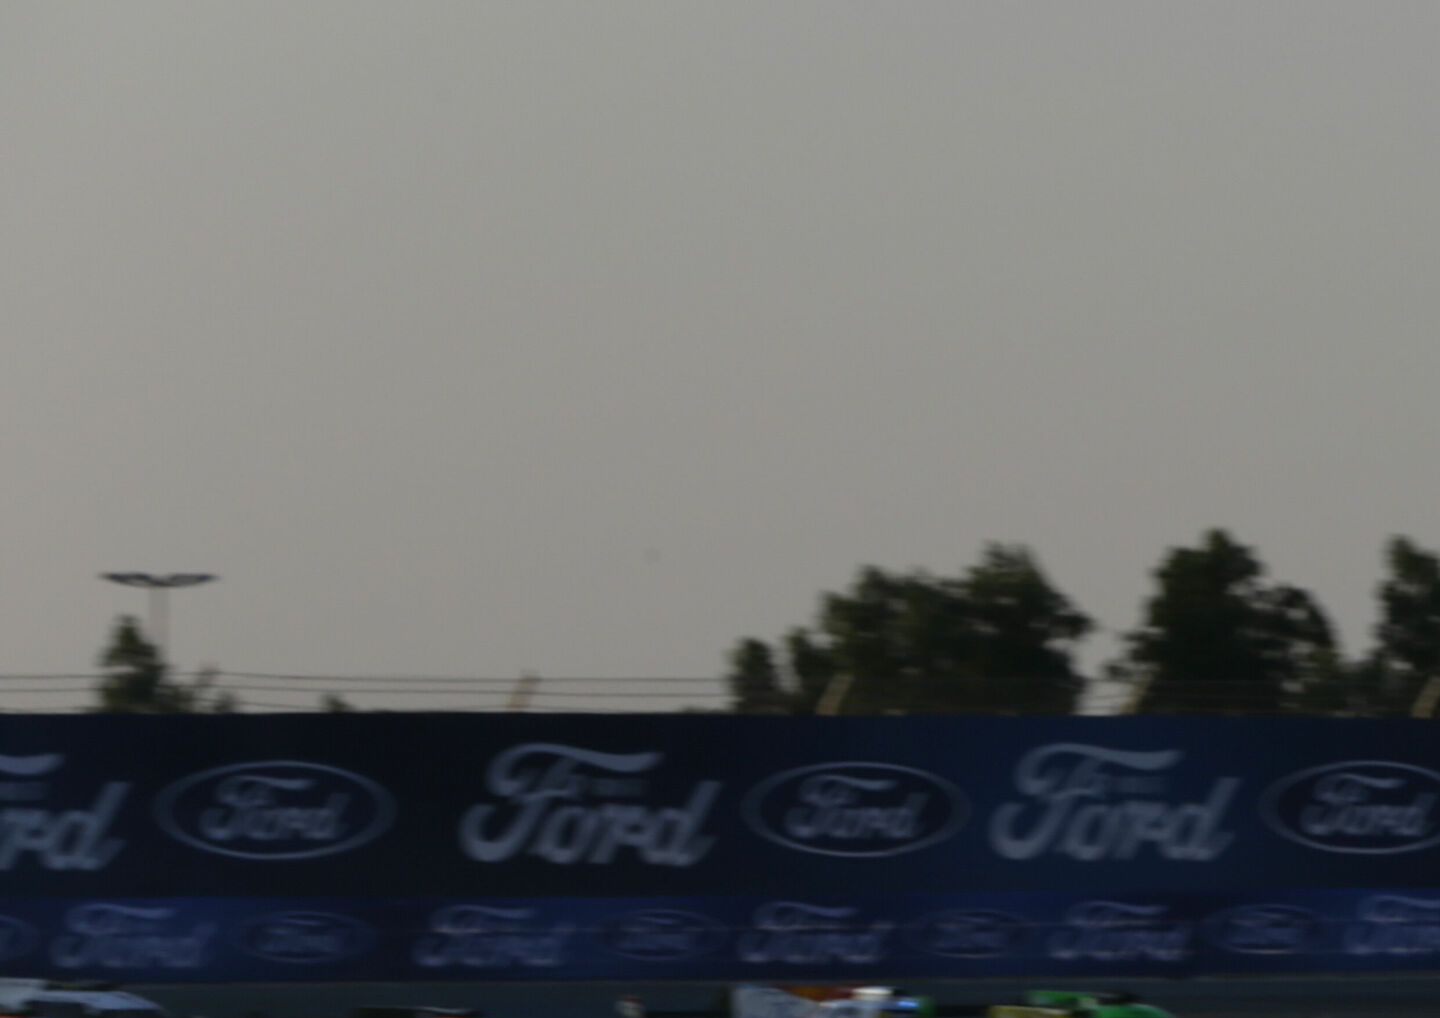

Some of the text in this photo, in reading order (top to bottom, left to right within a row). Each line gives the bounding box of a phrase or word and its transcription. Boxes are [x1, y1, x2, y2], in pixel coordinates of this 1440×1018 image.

[200, 774, 352, 841] Ford
[458, 742, 724, 868] Ford
[783, 774, 932, 840] Ford
[988, 743, 1245, 861] Ford
[1301, 772, 1439, 837] Ford
